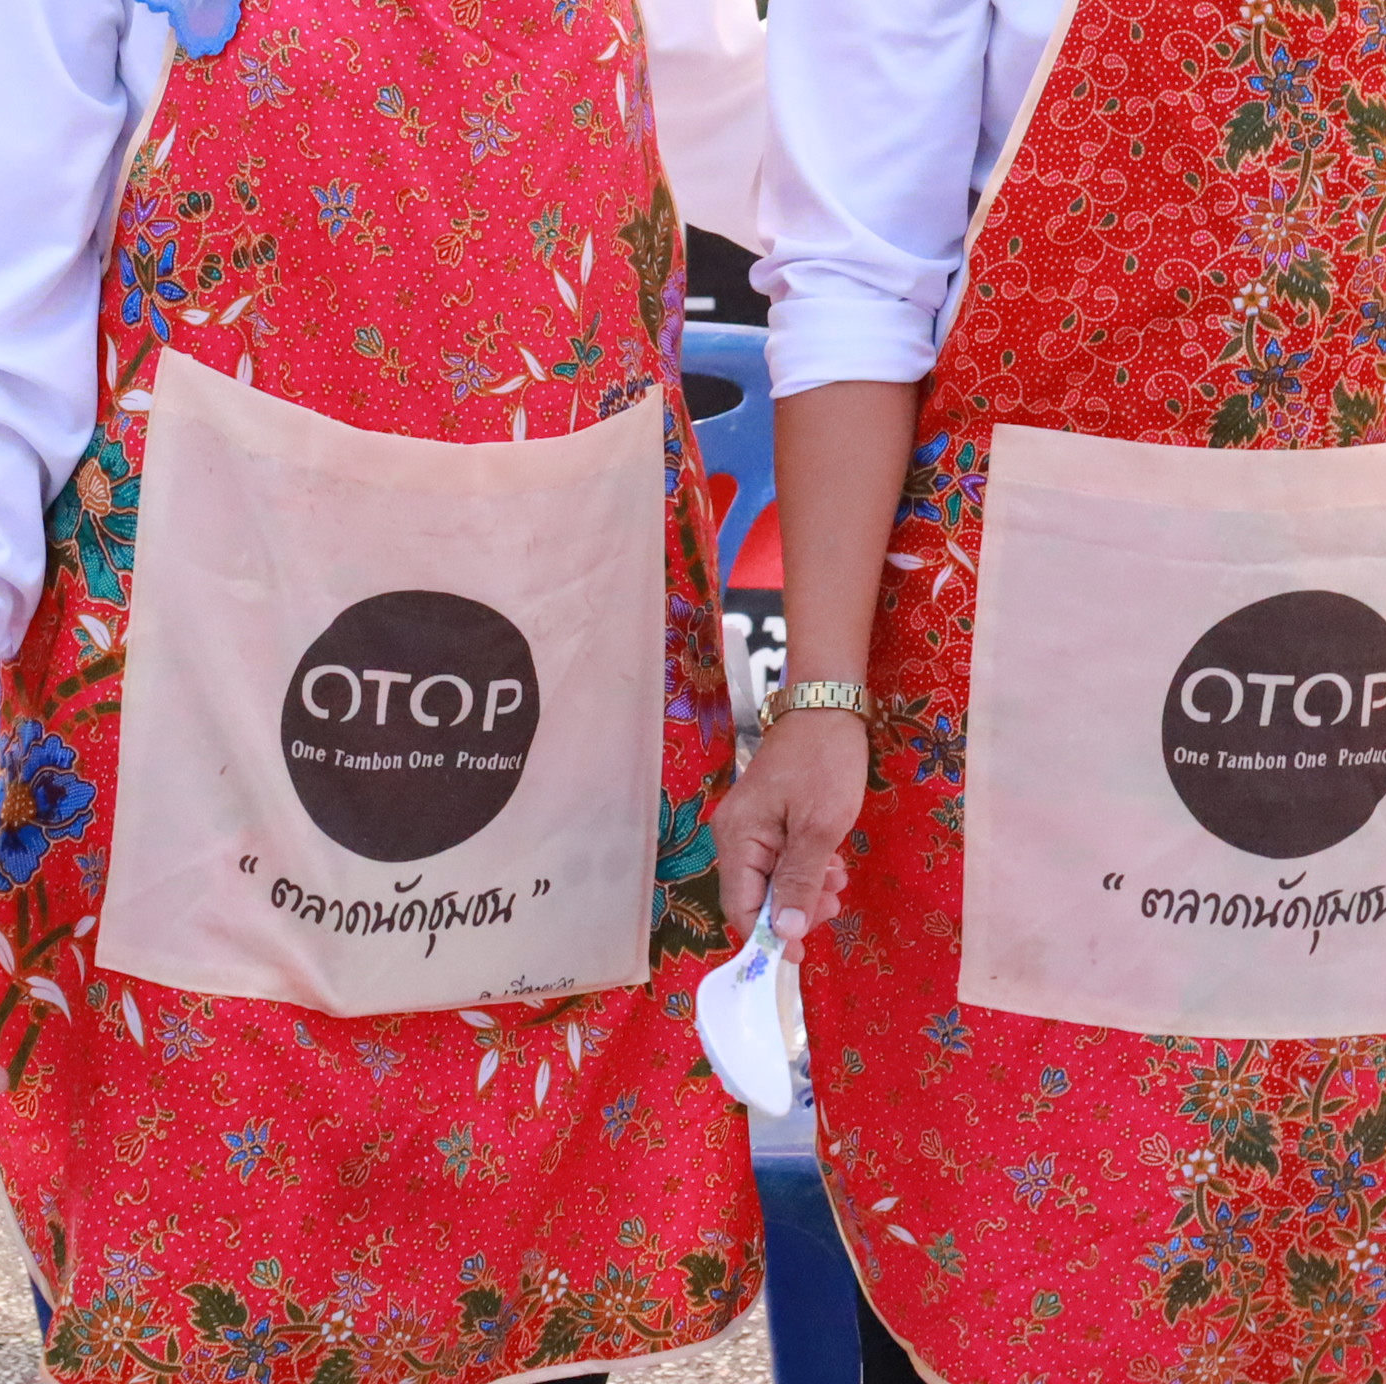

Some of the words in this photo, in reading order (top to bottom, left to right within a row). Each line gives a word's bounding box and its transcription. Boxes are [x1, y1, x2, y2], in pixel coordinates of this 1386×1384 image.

[301, 664, 524, 733] OTOP
[291, 739, 327, 764] One
[334, 749, 404, 772] Tambon
[408, 751, 445, 770] One
[456, 751, 523, 772] Product
[1173, 746, 1210, 767] One
[1216, 751, 1288, 770] Tambon
[1293, 751, 1328, 770] One
